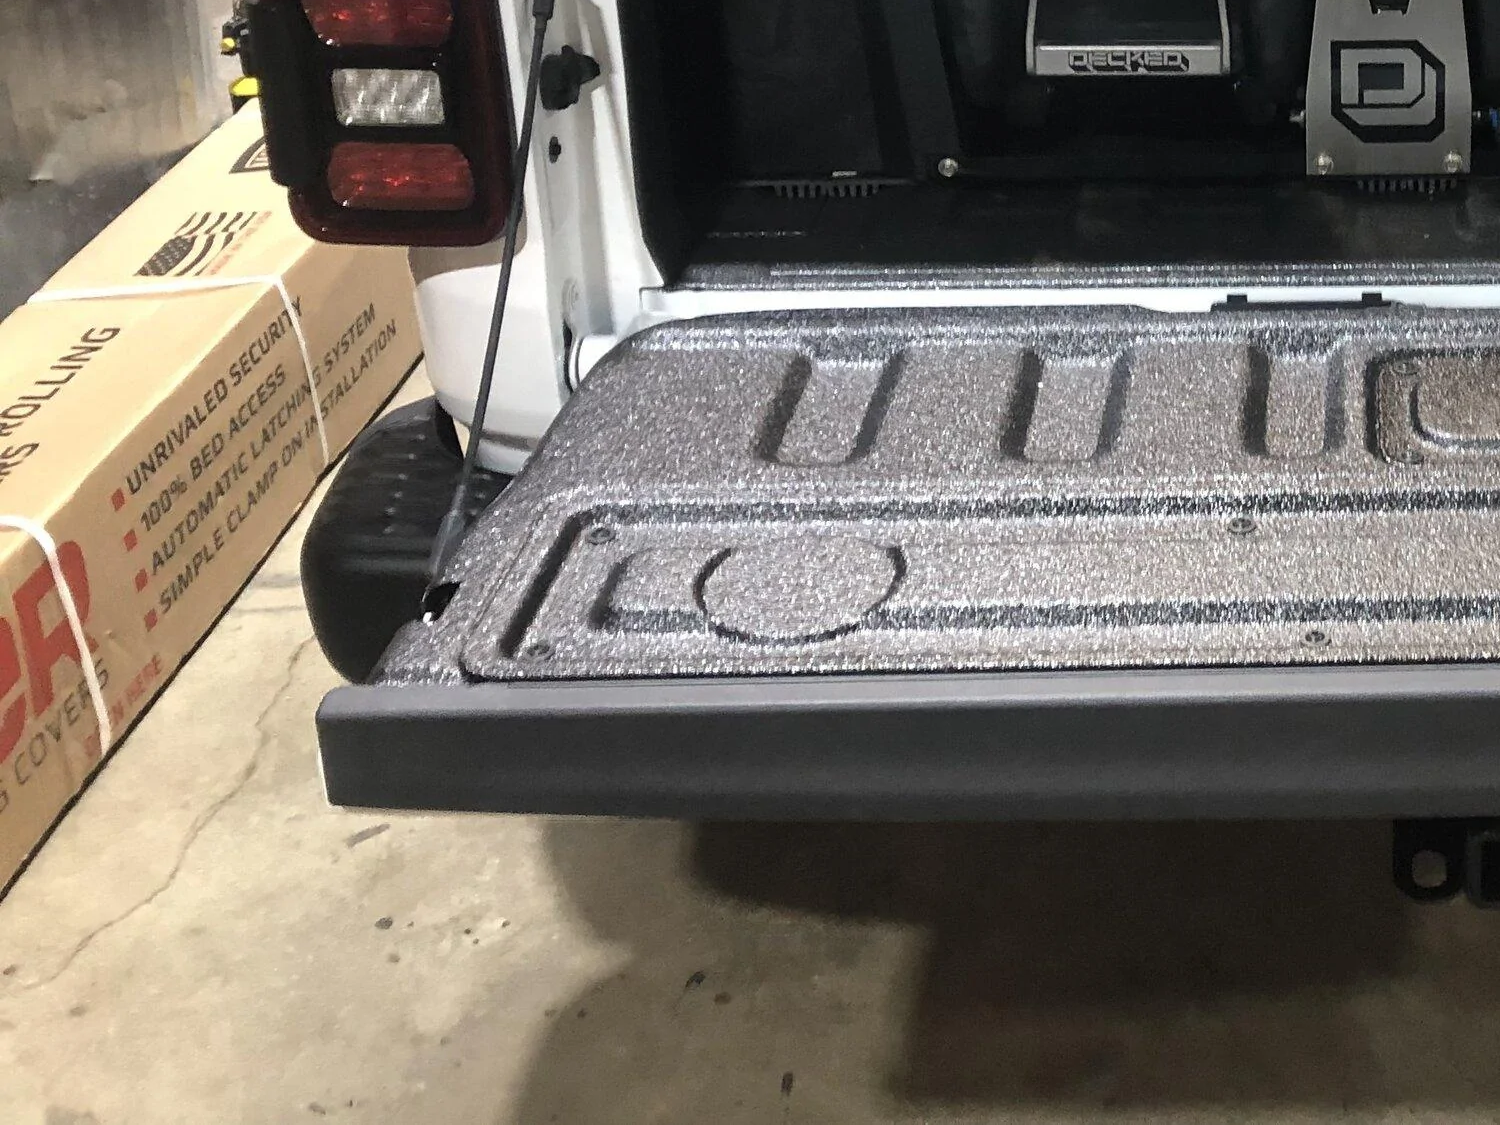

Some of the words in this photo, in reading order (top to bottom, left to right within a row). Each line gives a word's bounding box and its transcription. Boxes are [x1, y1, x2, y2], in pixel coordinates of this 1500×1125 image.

[1067, 49, 1190, 73] DECKED
[125, 378, 229, 495] UNRIVALED
[230, 296, 303, 387] SECURITY
[140, 475, 187, 532] 100%
[190, 430, 226, 482] BED
[229, 363, 288, 442] ACCESS
[150, 452, 248, 575] AUTOMATIC
[251, 368, 321, 460] LATCHING
[323, 302, 377, 371] SYSTEM
[158, 530, 225, 614] SIMPLE
[226, 465, 279, 533] CLAMP
[281, 436, 303, 466] ON
[305, 319, 397, 443] INSTALLATION
